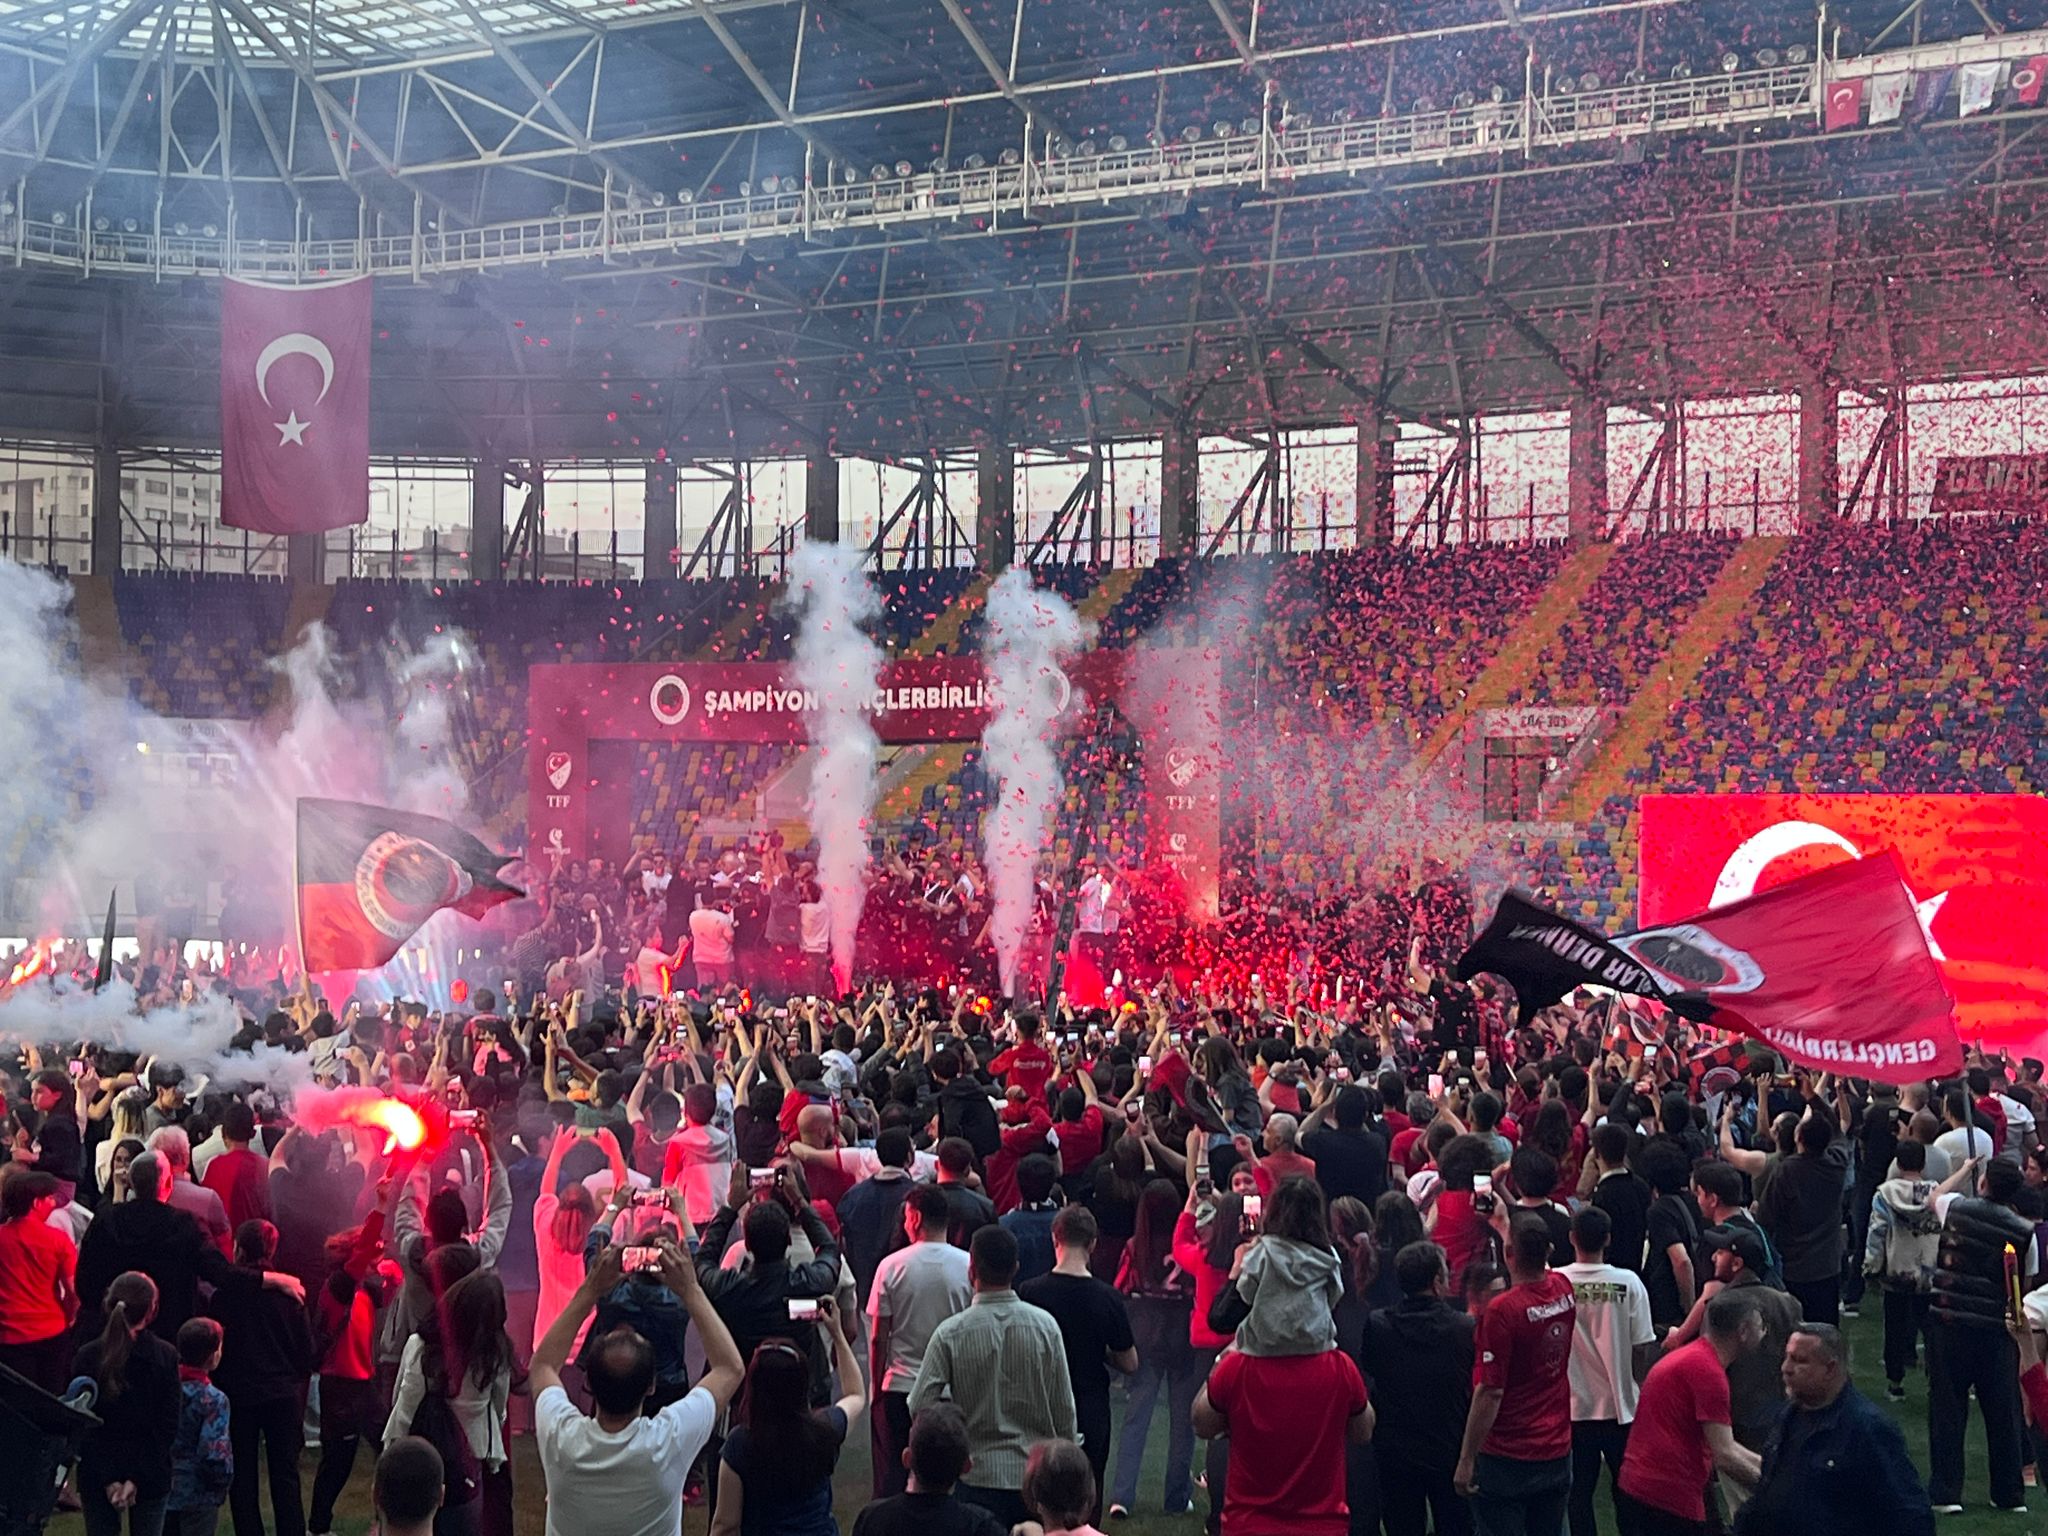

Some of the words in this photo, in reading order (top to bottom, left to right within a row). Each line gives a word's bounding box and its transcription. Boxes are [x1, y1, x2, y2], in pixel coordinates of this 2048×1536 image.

[704, 684, 819, 718] ŞAMPİYON
[855, 678, 997, 717] NÇLERBİRLİ
[546, 795, 571, 808] TFF
[1164, 795, 1196, 810] TFF
